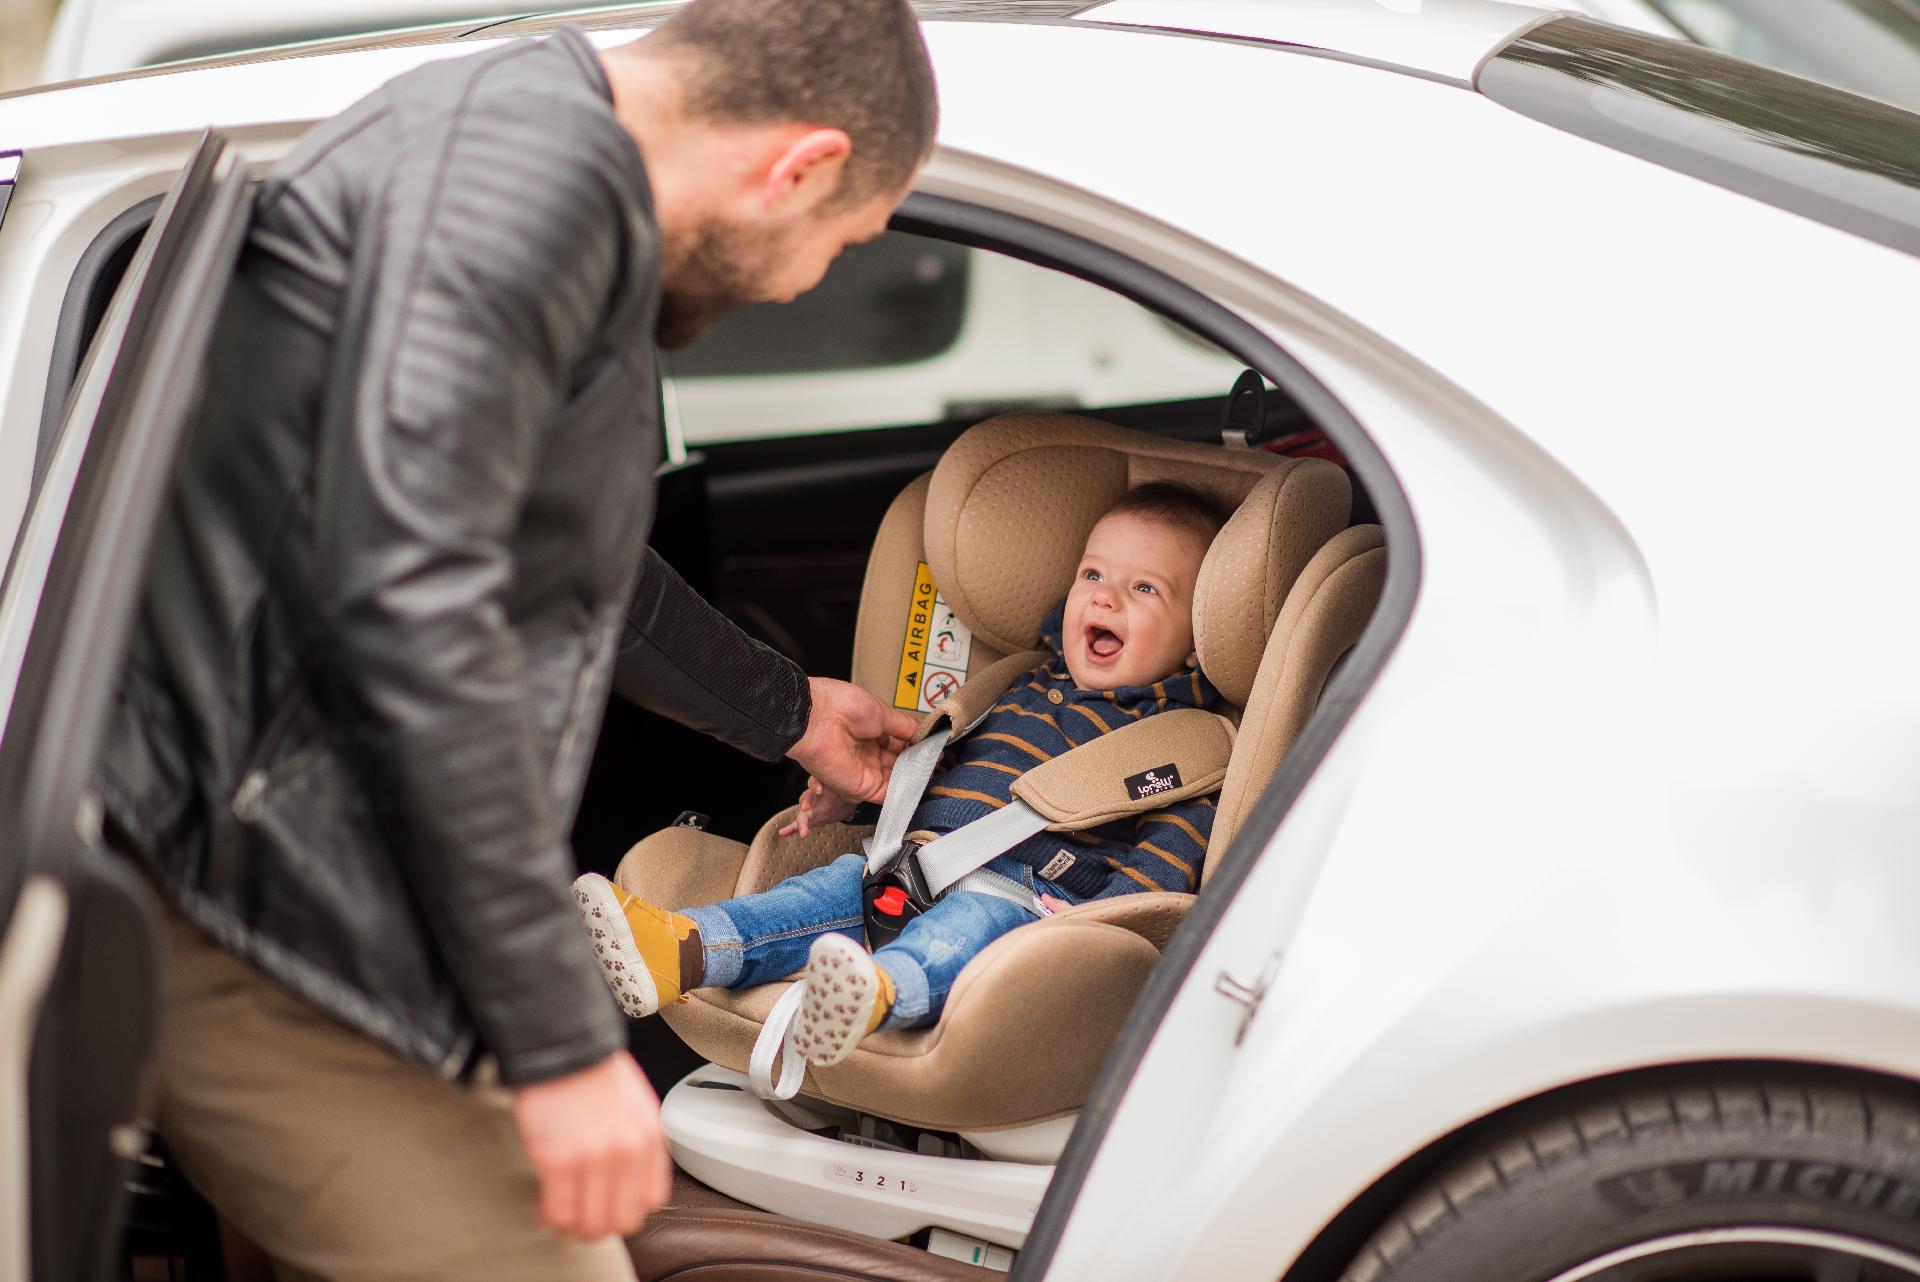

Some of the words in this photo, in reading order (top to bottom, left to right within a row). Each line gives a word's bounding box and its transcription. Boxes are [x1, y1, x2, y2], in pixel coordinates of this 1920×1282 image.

[908, 583, 932, 662] AIRBAG
[855, 1171, 864, 1182] 3
[876, 1176, 885, 1186] 2
[900, 1180, 906, 1191] 1
